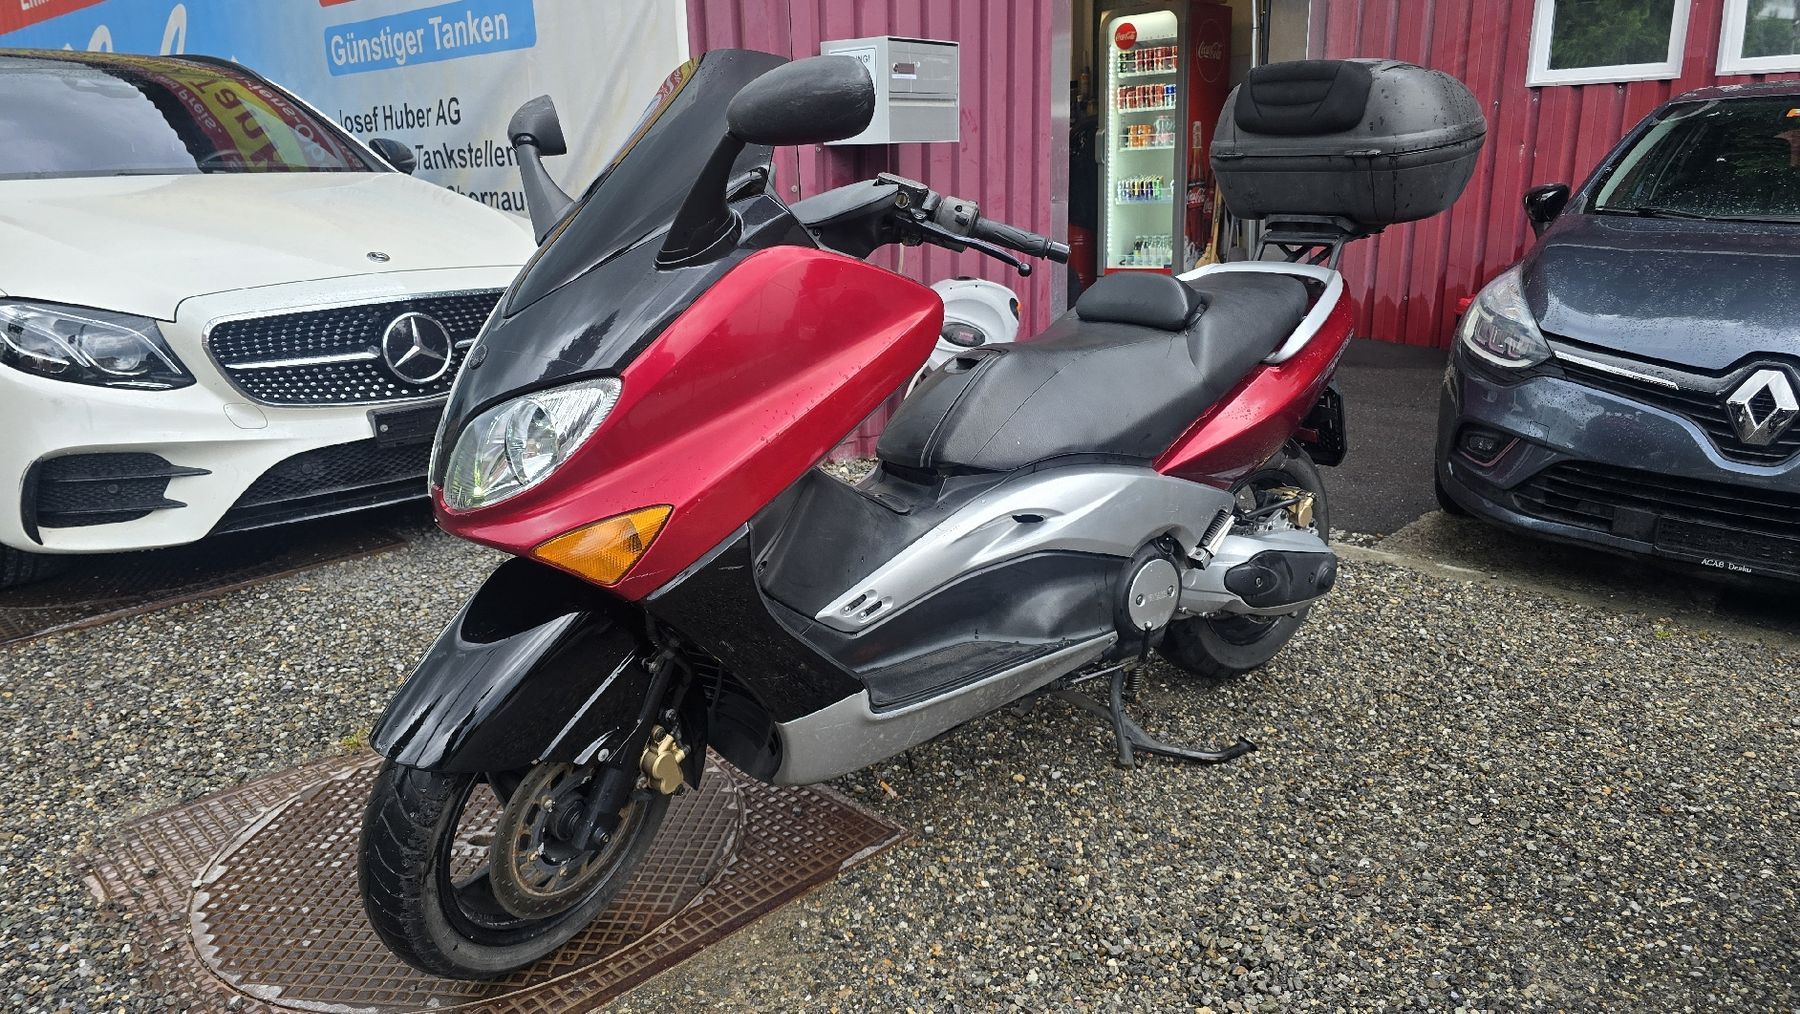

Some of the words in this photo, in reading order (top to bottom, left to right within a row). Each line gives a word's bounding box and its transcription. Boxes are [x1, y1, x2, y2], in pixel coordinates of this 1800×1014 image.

[331, 26, 424, 66] Günstiger
[428, 10, 509, 50] Tanken
[382, 103, 432, 131] Huber
[436, 97, 461, 125] AG
[415, 140, 521, 170] Tankstellen
[446, 184, 525, 212] ernau
